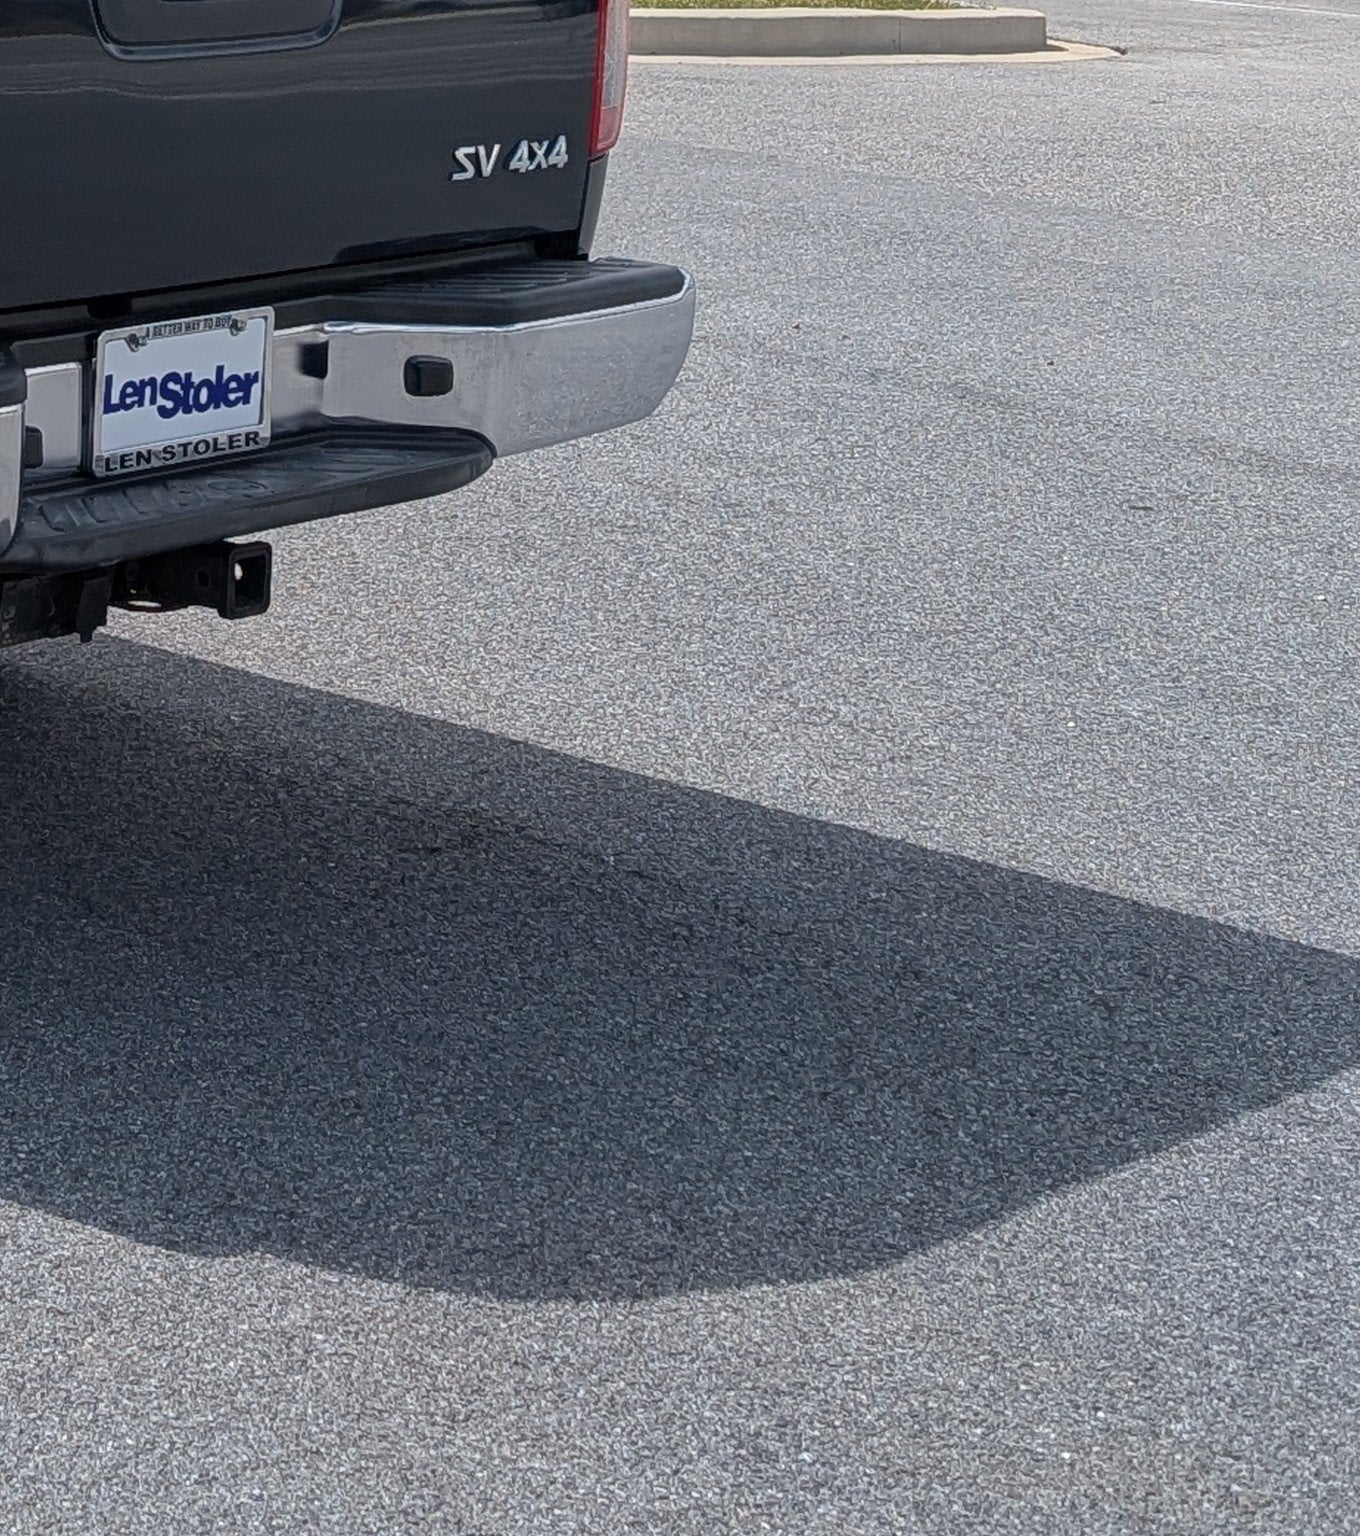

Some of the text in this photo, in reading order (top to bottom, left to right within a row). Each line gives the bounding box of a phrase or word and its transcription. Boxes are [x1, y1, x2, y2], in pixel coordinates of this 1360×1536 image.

[451, 143, 502, 181] SV
[104, 430, 261, 473] LEN STOLER
